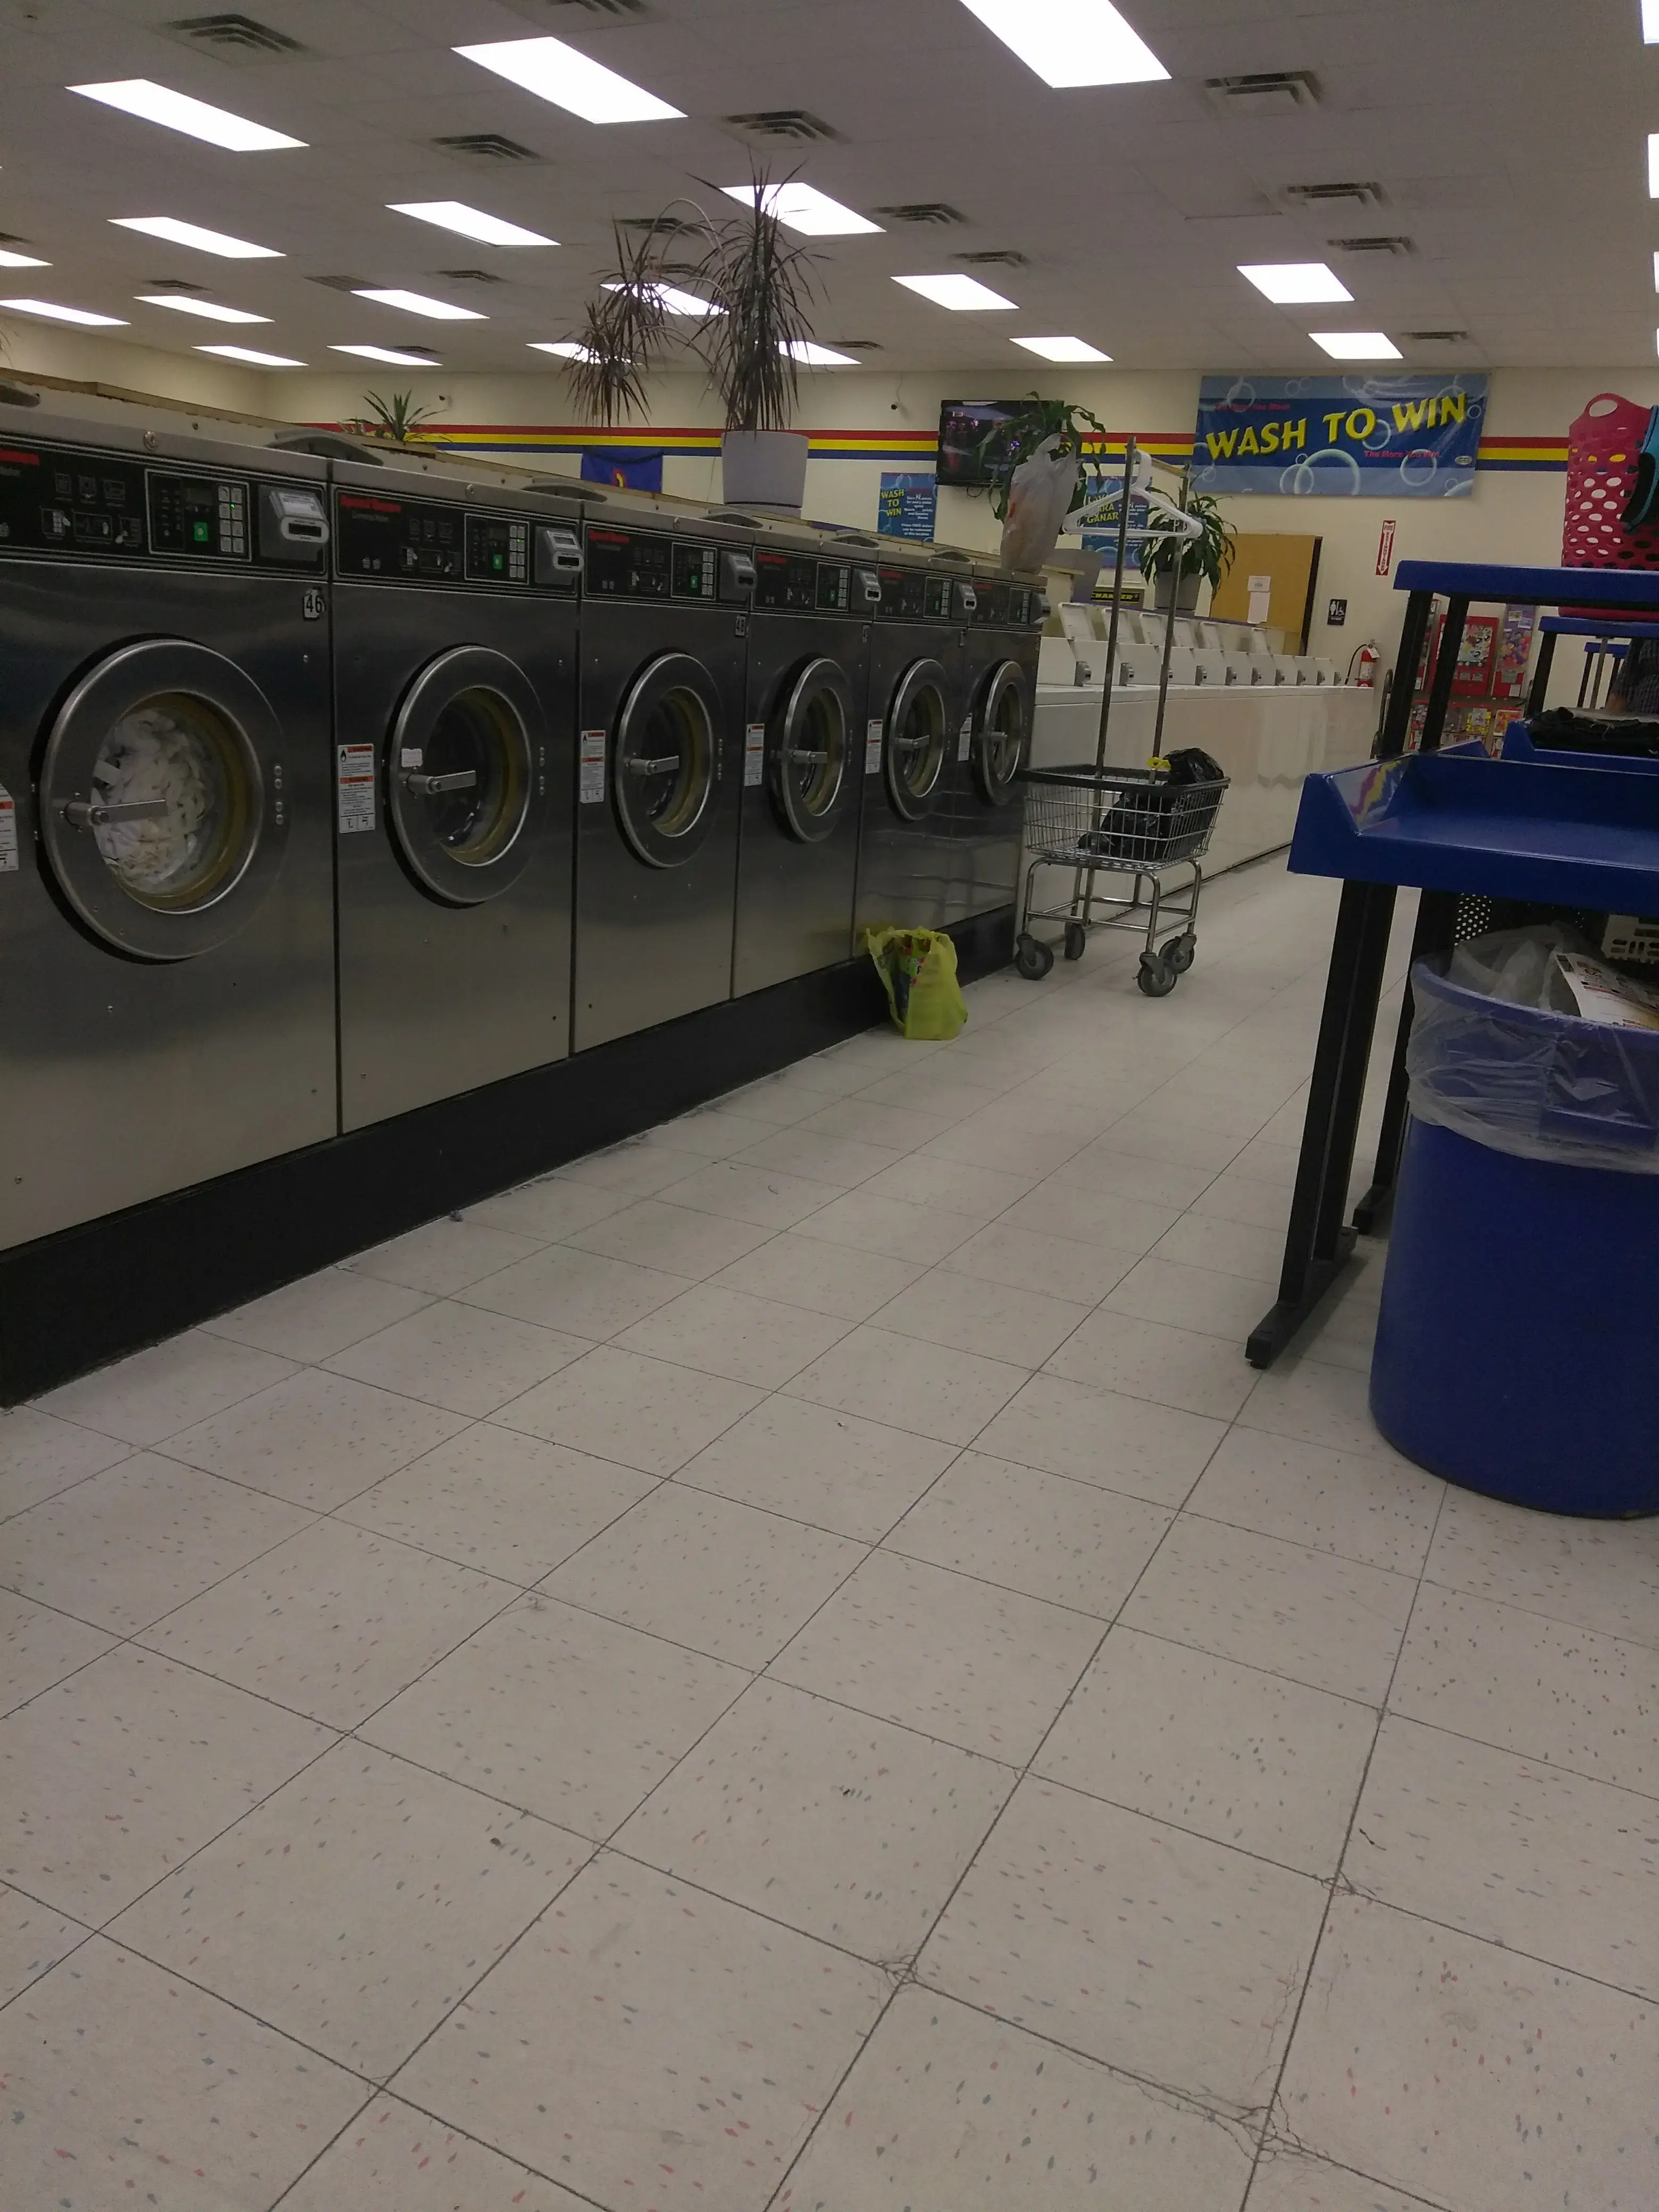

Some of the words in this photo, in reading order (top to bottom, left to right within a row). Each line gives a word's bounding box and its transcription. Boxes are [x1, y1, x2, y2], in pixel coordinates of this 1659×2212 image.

[1205, 418, 1307, 460] WASH
[1323, 408, 1376, 443] TO
[1392, 393, 1467, 433] WIN
[881, 489, 904, 499] WASH
[887, 499, 900, 507] TO
[886, 508, 902, 517] WIN
[1086, 512, 1119, 524] GANAR
[306, 594, 323, 614] 46
